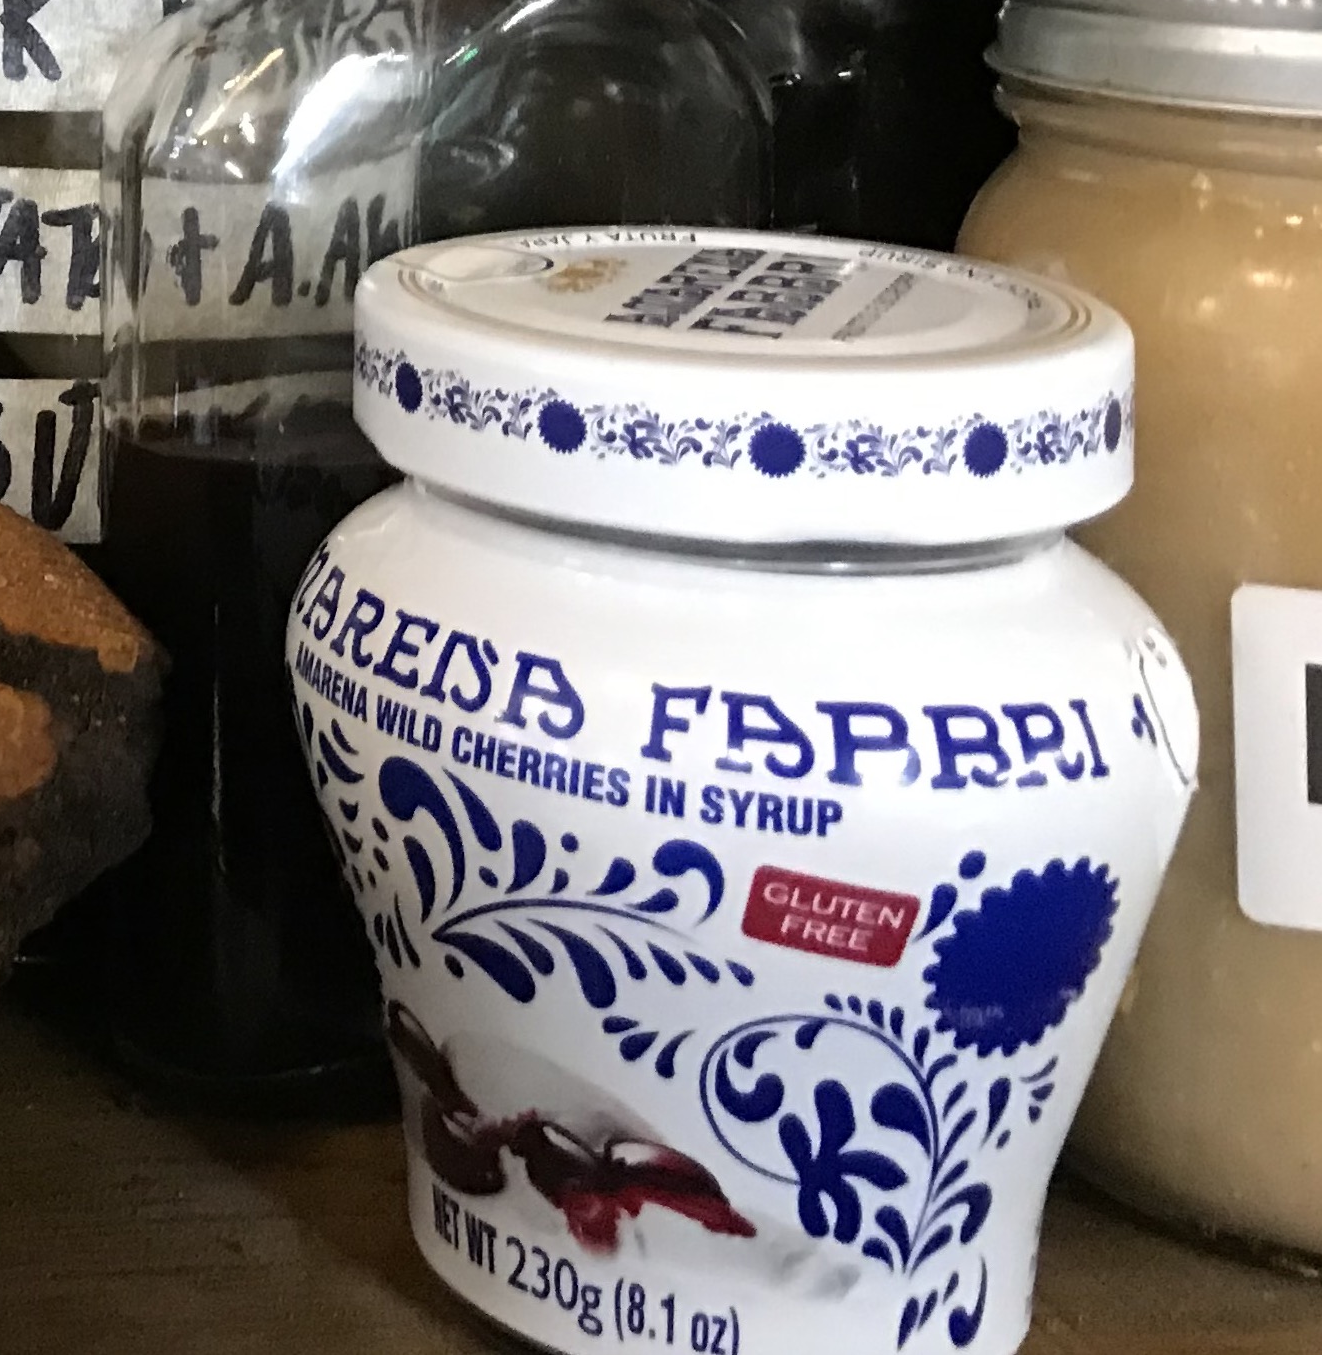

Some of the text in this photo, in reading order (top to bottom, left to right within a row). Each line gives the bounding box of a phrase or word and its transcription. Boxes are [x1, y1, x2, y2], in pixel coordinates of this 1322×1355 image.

[376, 695, 443, 753] WILD
[452, 726, 631, 807] CHERRIES
[645, 775, 687, 818] IN
[699, 790, 843, 837] SYRUP
[762, 881, 905, 930] GLUTEN
[780, 913, 874, 952] FREE
[432, 1183, 741, 1355] NET WT 230g (8.1 oz)
